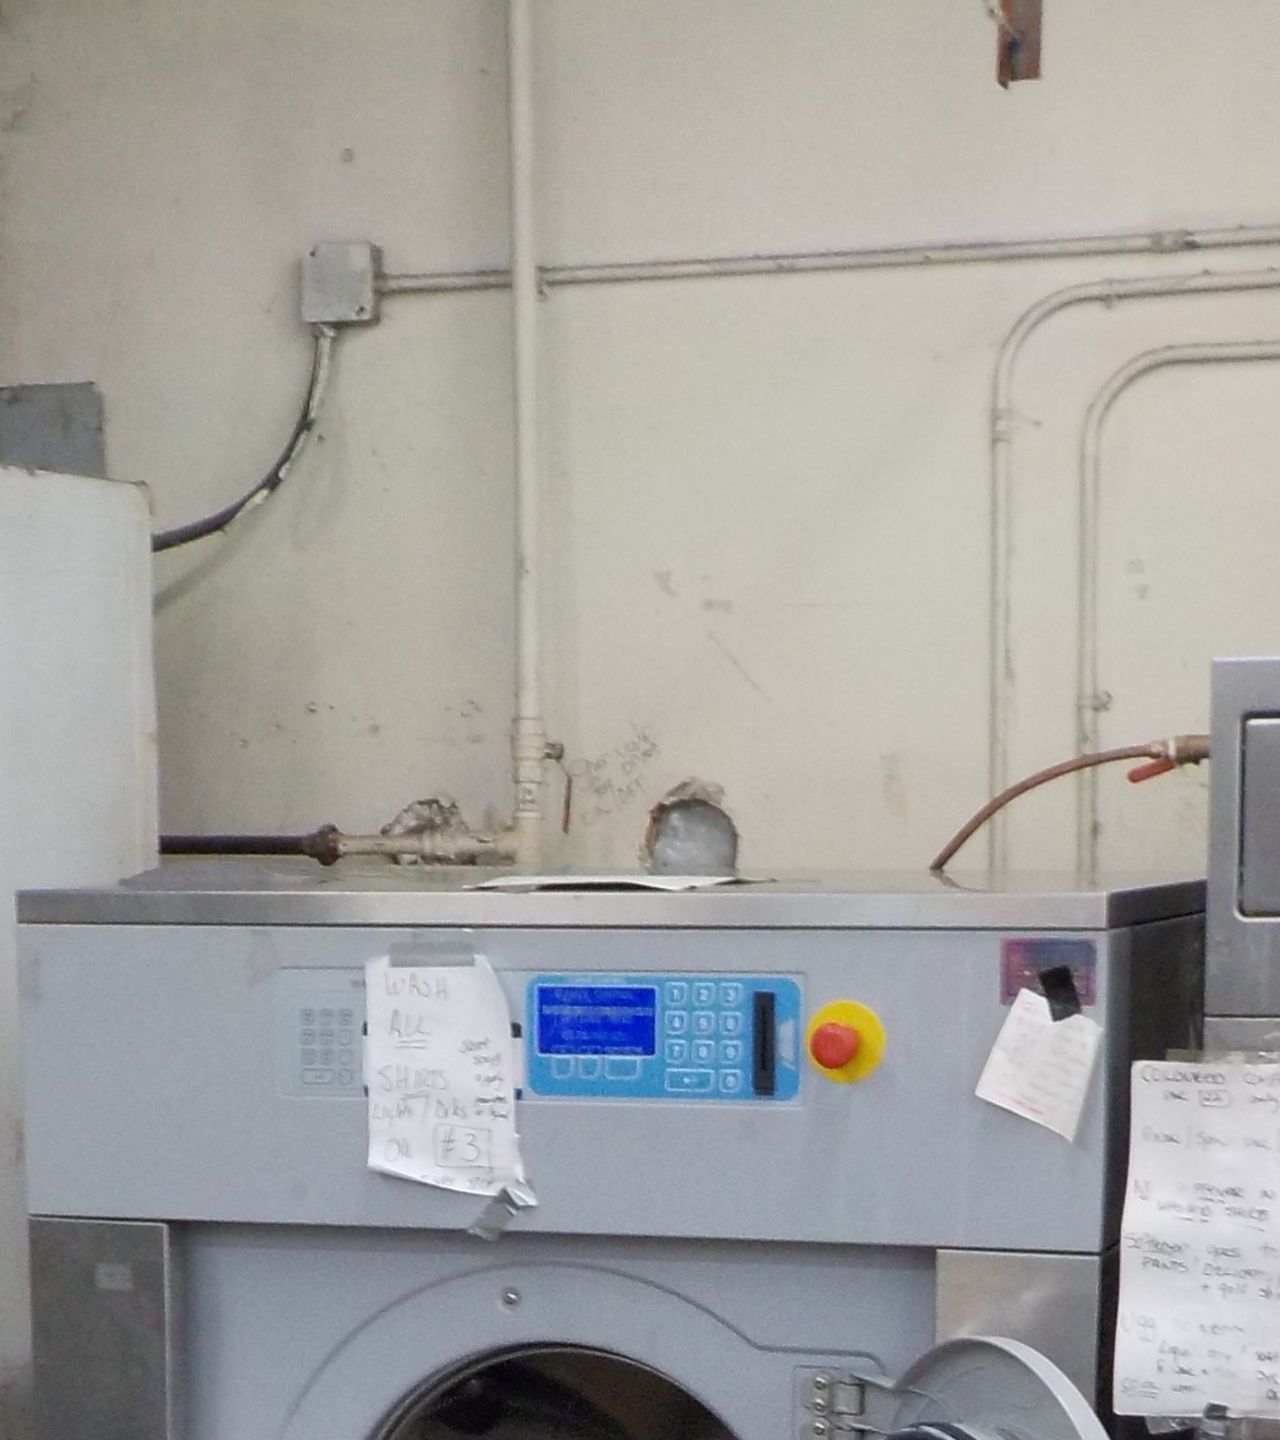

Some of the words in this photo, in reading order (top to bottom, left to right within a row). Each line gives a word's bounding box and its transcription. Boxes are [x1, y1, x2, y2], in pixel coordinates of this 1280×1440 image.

[384, 972, 448, 999] WASH
[389, 1008, 431, 1037] ALL
[440, 1127, 481, 1162] #3
